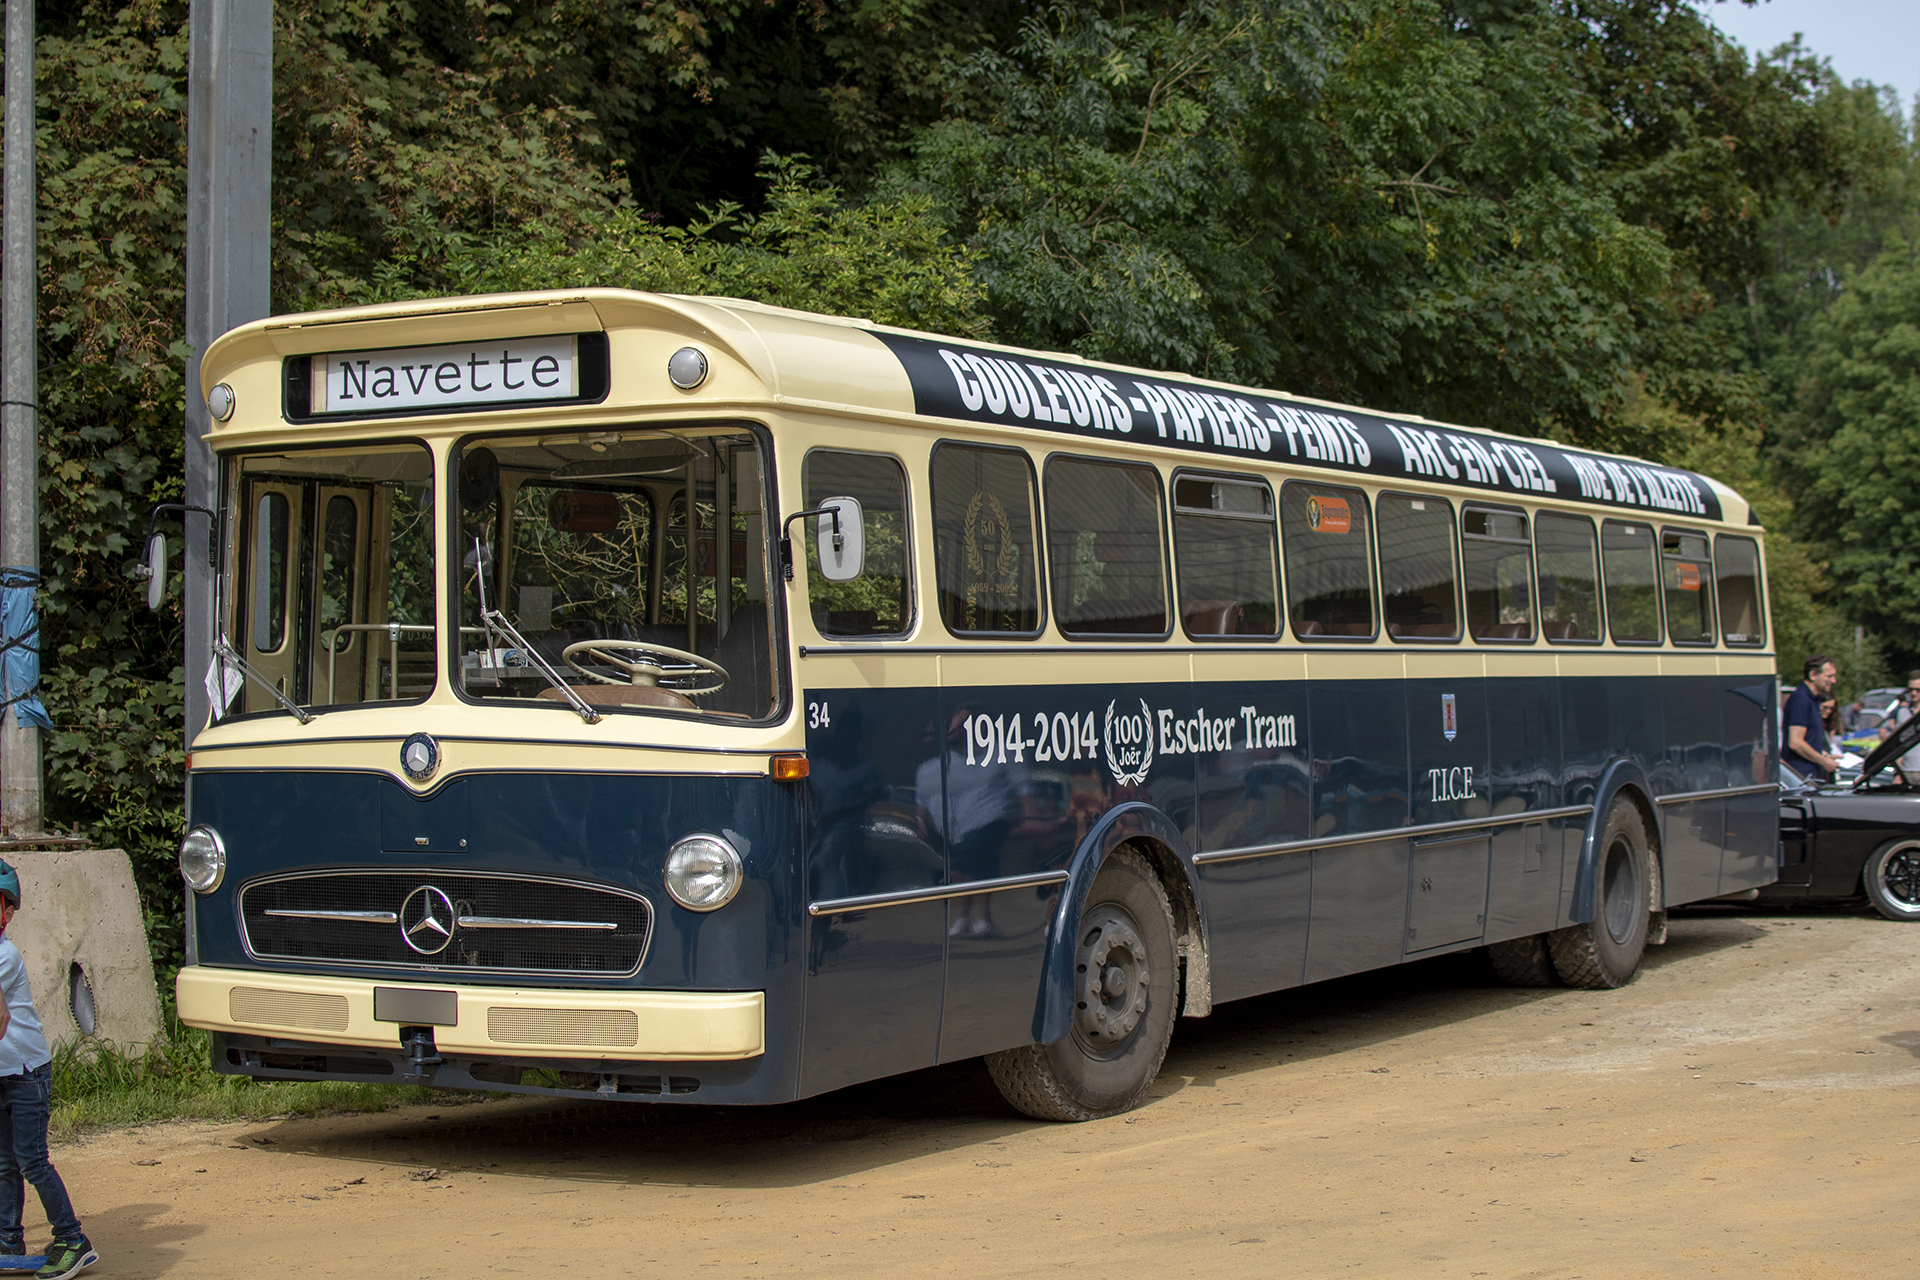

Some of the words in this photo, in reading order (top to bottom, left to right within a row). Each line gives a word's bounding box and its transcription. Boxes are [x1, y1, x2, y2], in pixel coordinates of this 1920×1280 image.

[338, 350, 560, 400] Navette
[1562, 453, 1613, 500] RUE
[1597, 459, 1637, 504] DE
[1620, 463, 1707, 515] L'ALZETTE
[980, 520, 995, 536] 50
[808, 702, 831, 729] 34
[963, 710, 1099, 768] 1914-2014
[1114, 714, 1143, 745] 100
[1157, 708, 1236, 755] Escher
[1240, 706, 1297, 749] Tram
[1118, 746, 1141, 767] Joër
